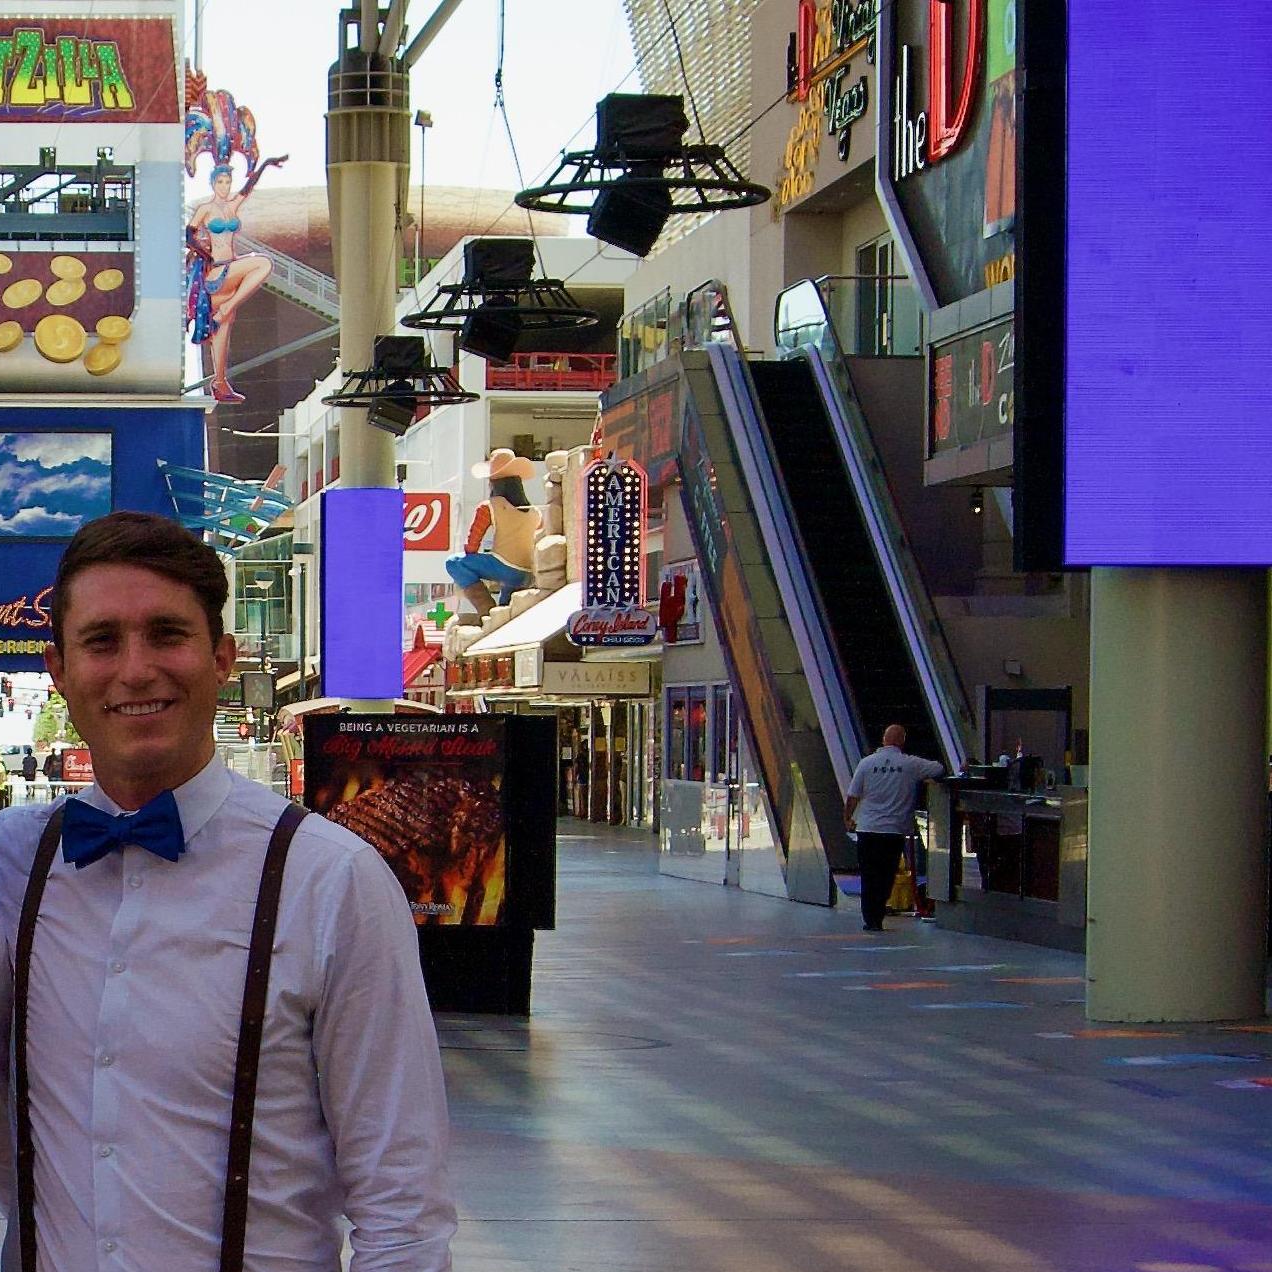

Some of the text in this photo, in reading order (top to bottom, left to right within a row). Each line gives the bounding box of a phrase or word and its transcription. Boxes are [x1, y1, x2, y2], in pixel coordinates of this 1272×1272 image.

[894, 44, 926, 182] the
[605, 475, 624, 603] AMERICAN
[573, 612, 649, 643] Coney Island
[339, 722, 479, 733] BEING A VEGETARIAN IS A
